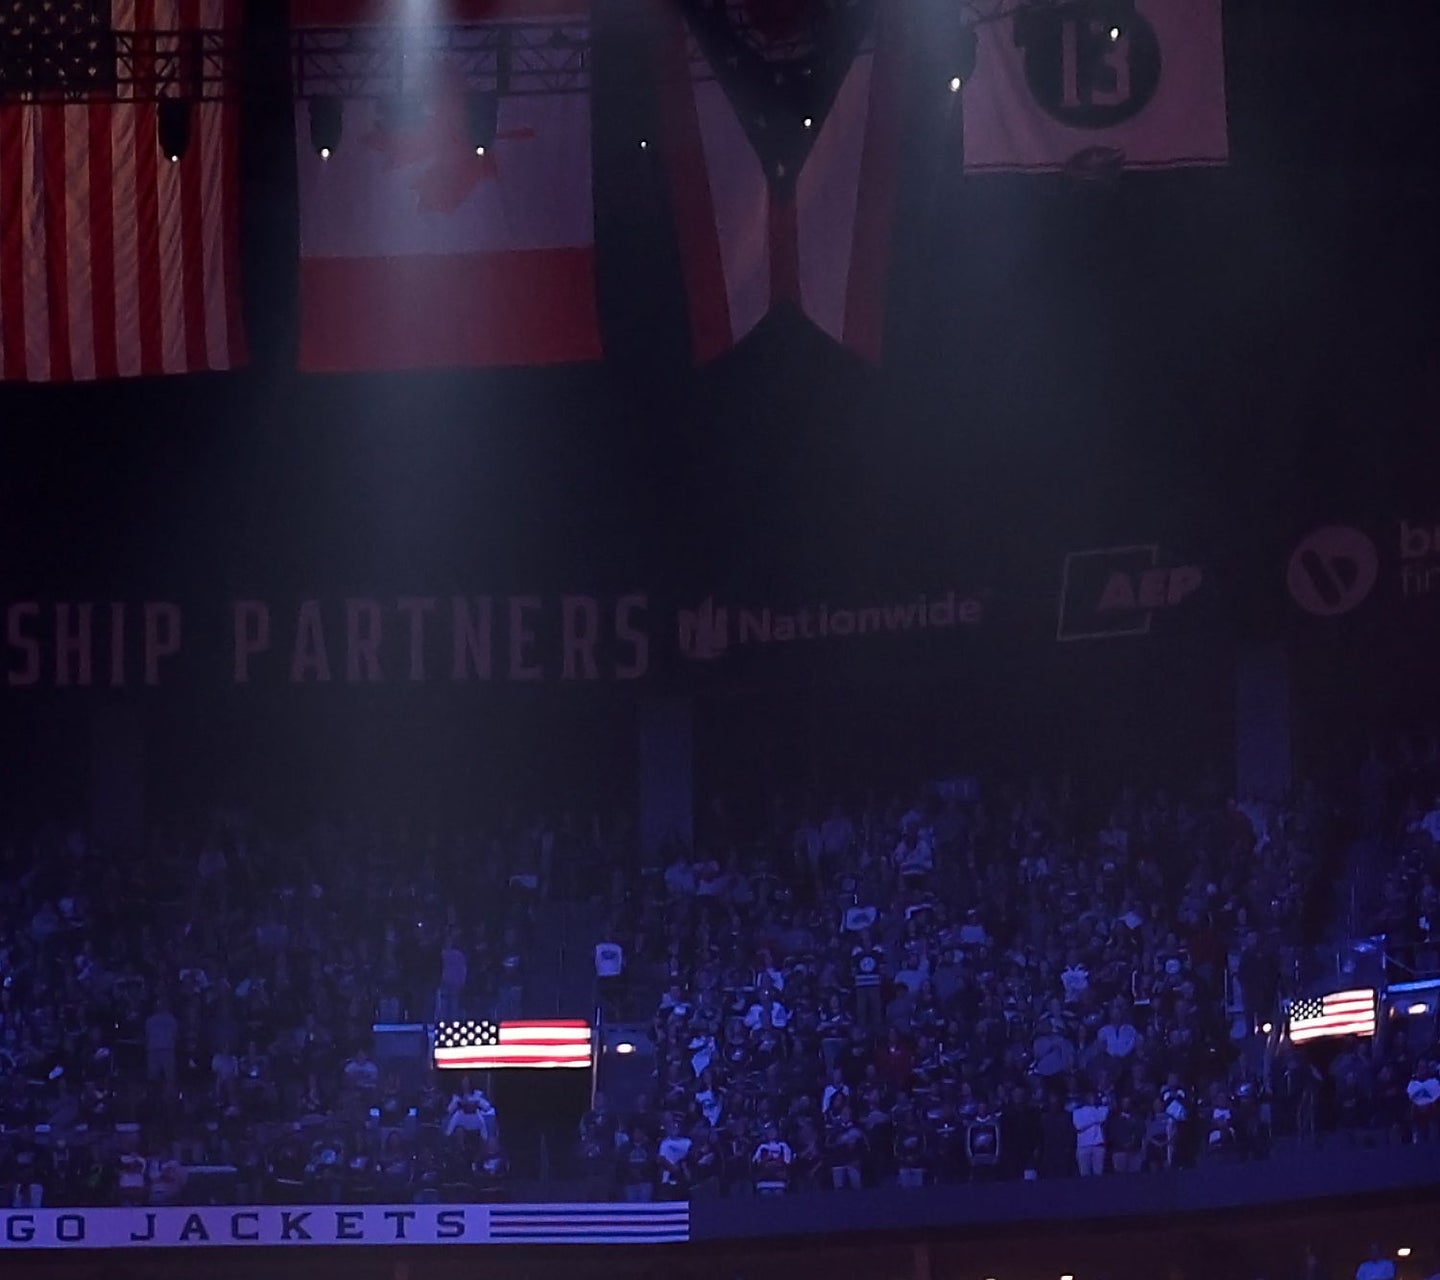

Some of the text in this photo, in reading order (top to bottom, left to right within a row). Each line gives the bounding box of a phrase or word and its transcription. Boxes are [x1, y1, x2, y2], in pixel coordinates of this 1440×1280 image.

[1061, 17, 1130, 106] 13
[1097, 564, 1202, 612] AEP
[233, 594, 652, 686] PARTNERS
[738, 591, 984, 646] Nationwide
[5, 1213, 87, 1244] GO
[130, 1211, 469, 1245] JACKETS
